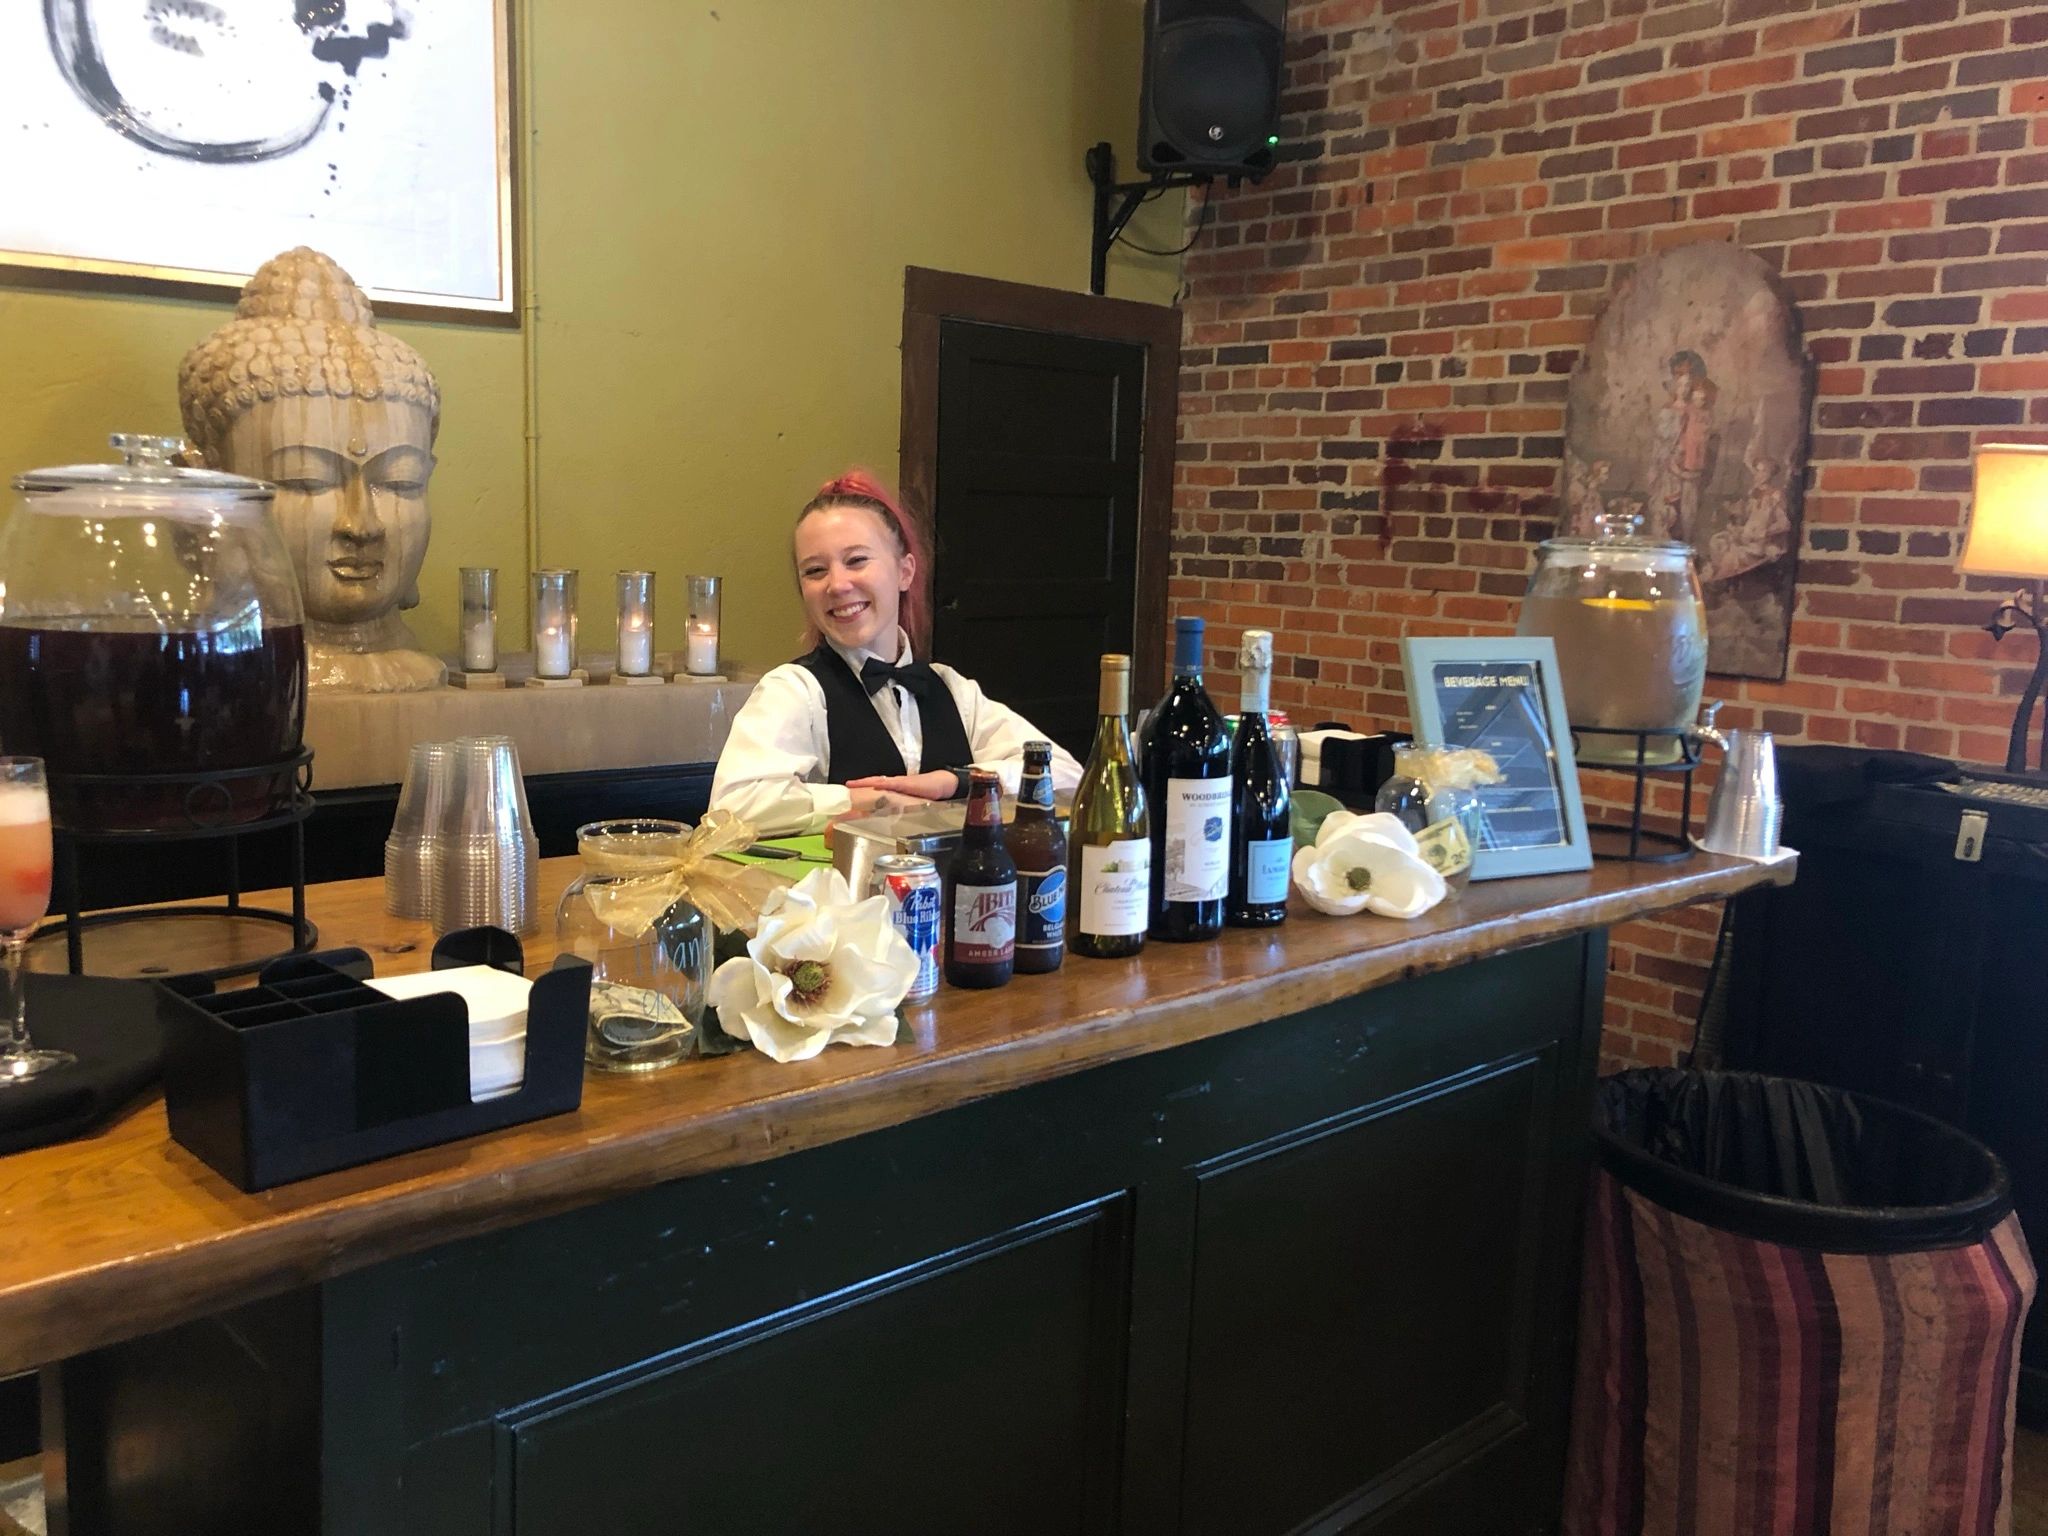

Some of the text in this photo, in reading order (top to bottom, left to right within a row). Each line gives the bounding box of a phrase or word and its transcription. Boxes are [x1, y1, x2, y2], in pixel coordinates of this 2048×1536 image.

[1443, 675, 1530, 688] BEVERAGE MENU
[909, 889, 936, 911] Pabst
[965, 890, 1014, 928] ABIT
[894, 910, 918, 925] Blue
[968, 949, 998, 957] AMBER
